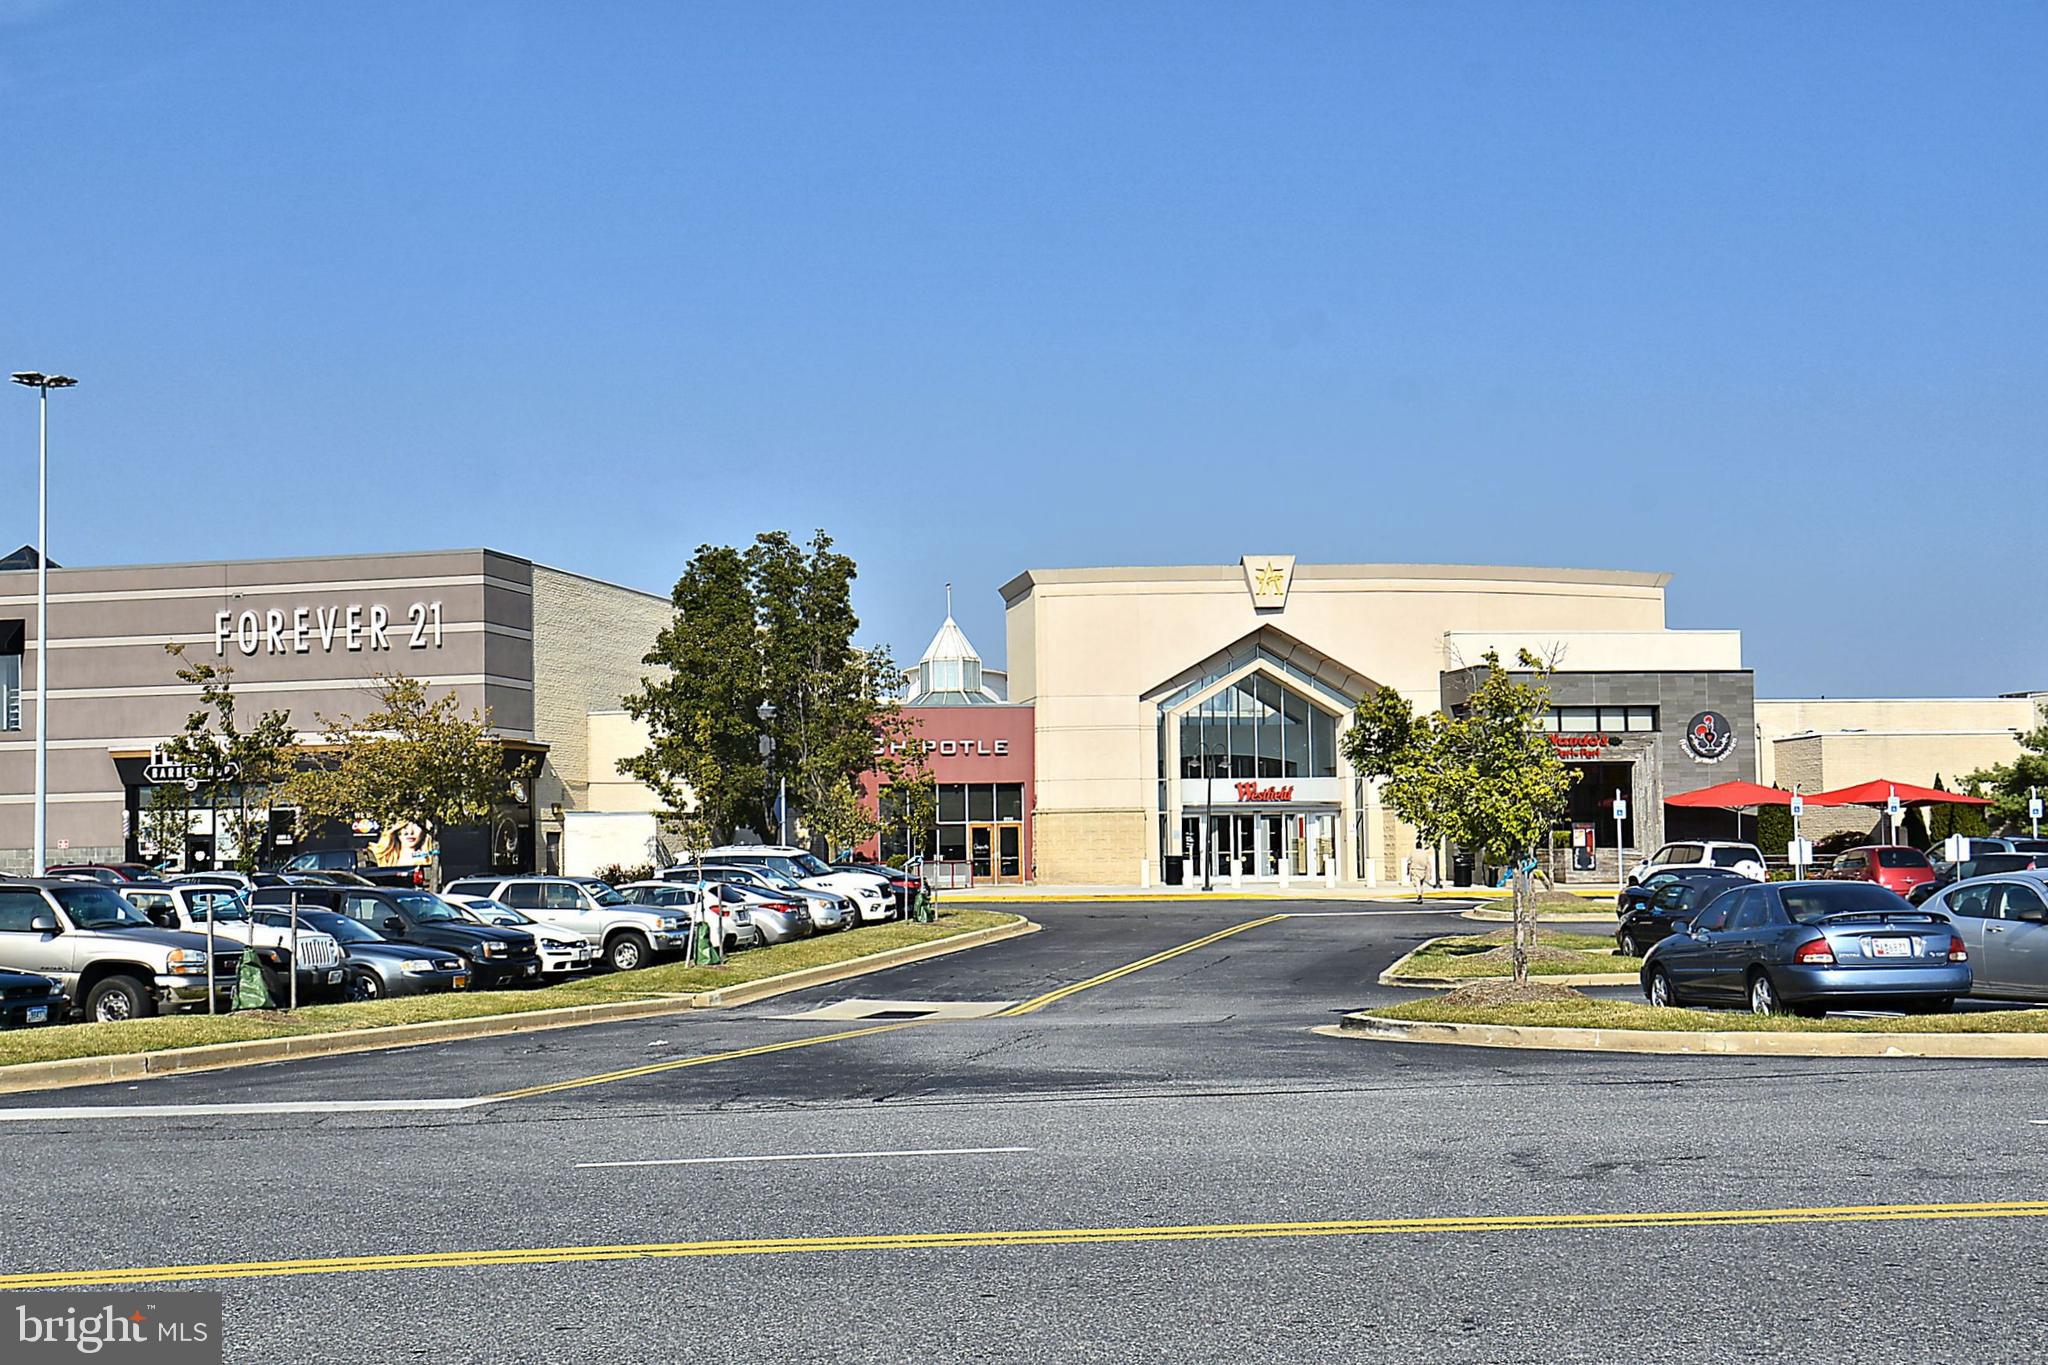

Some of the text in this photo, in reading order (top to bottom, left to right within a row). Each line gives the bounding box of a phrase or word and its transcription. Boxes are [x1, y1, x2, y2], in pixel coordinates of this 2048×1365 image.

[215, 601, 443, 656] FOREVER 21
[873, 737, 1008, 756] CHPOTLE
[1234, 781, 1294, 802] Westfield
